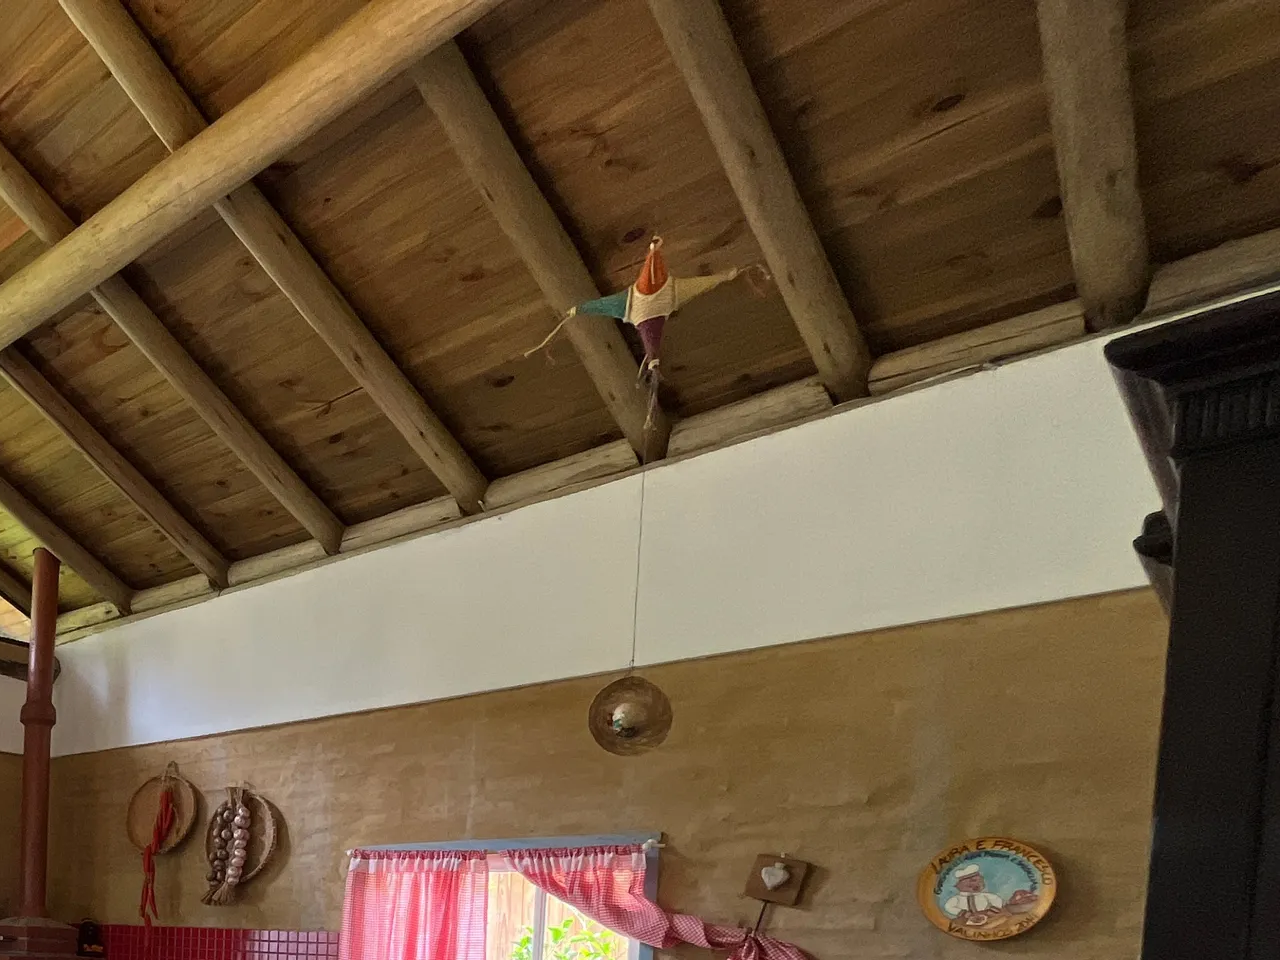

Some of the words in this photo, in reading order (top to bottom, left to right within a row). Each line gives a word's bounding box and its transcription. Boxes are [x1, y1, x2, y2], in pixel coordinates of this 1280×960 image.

[930, 845, 970, 874] LAURA
[975, 840, 986, 850] E
[991, 840, 1053, 886] FRANCESCO
[948, 921, 1014, 939] VALINHOS
